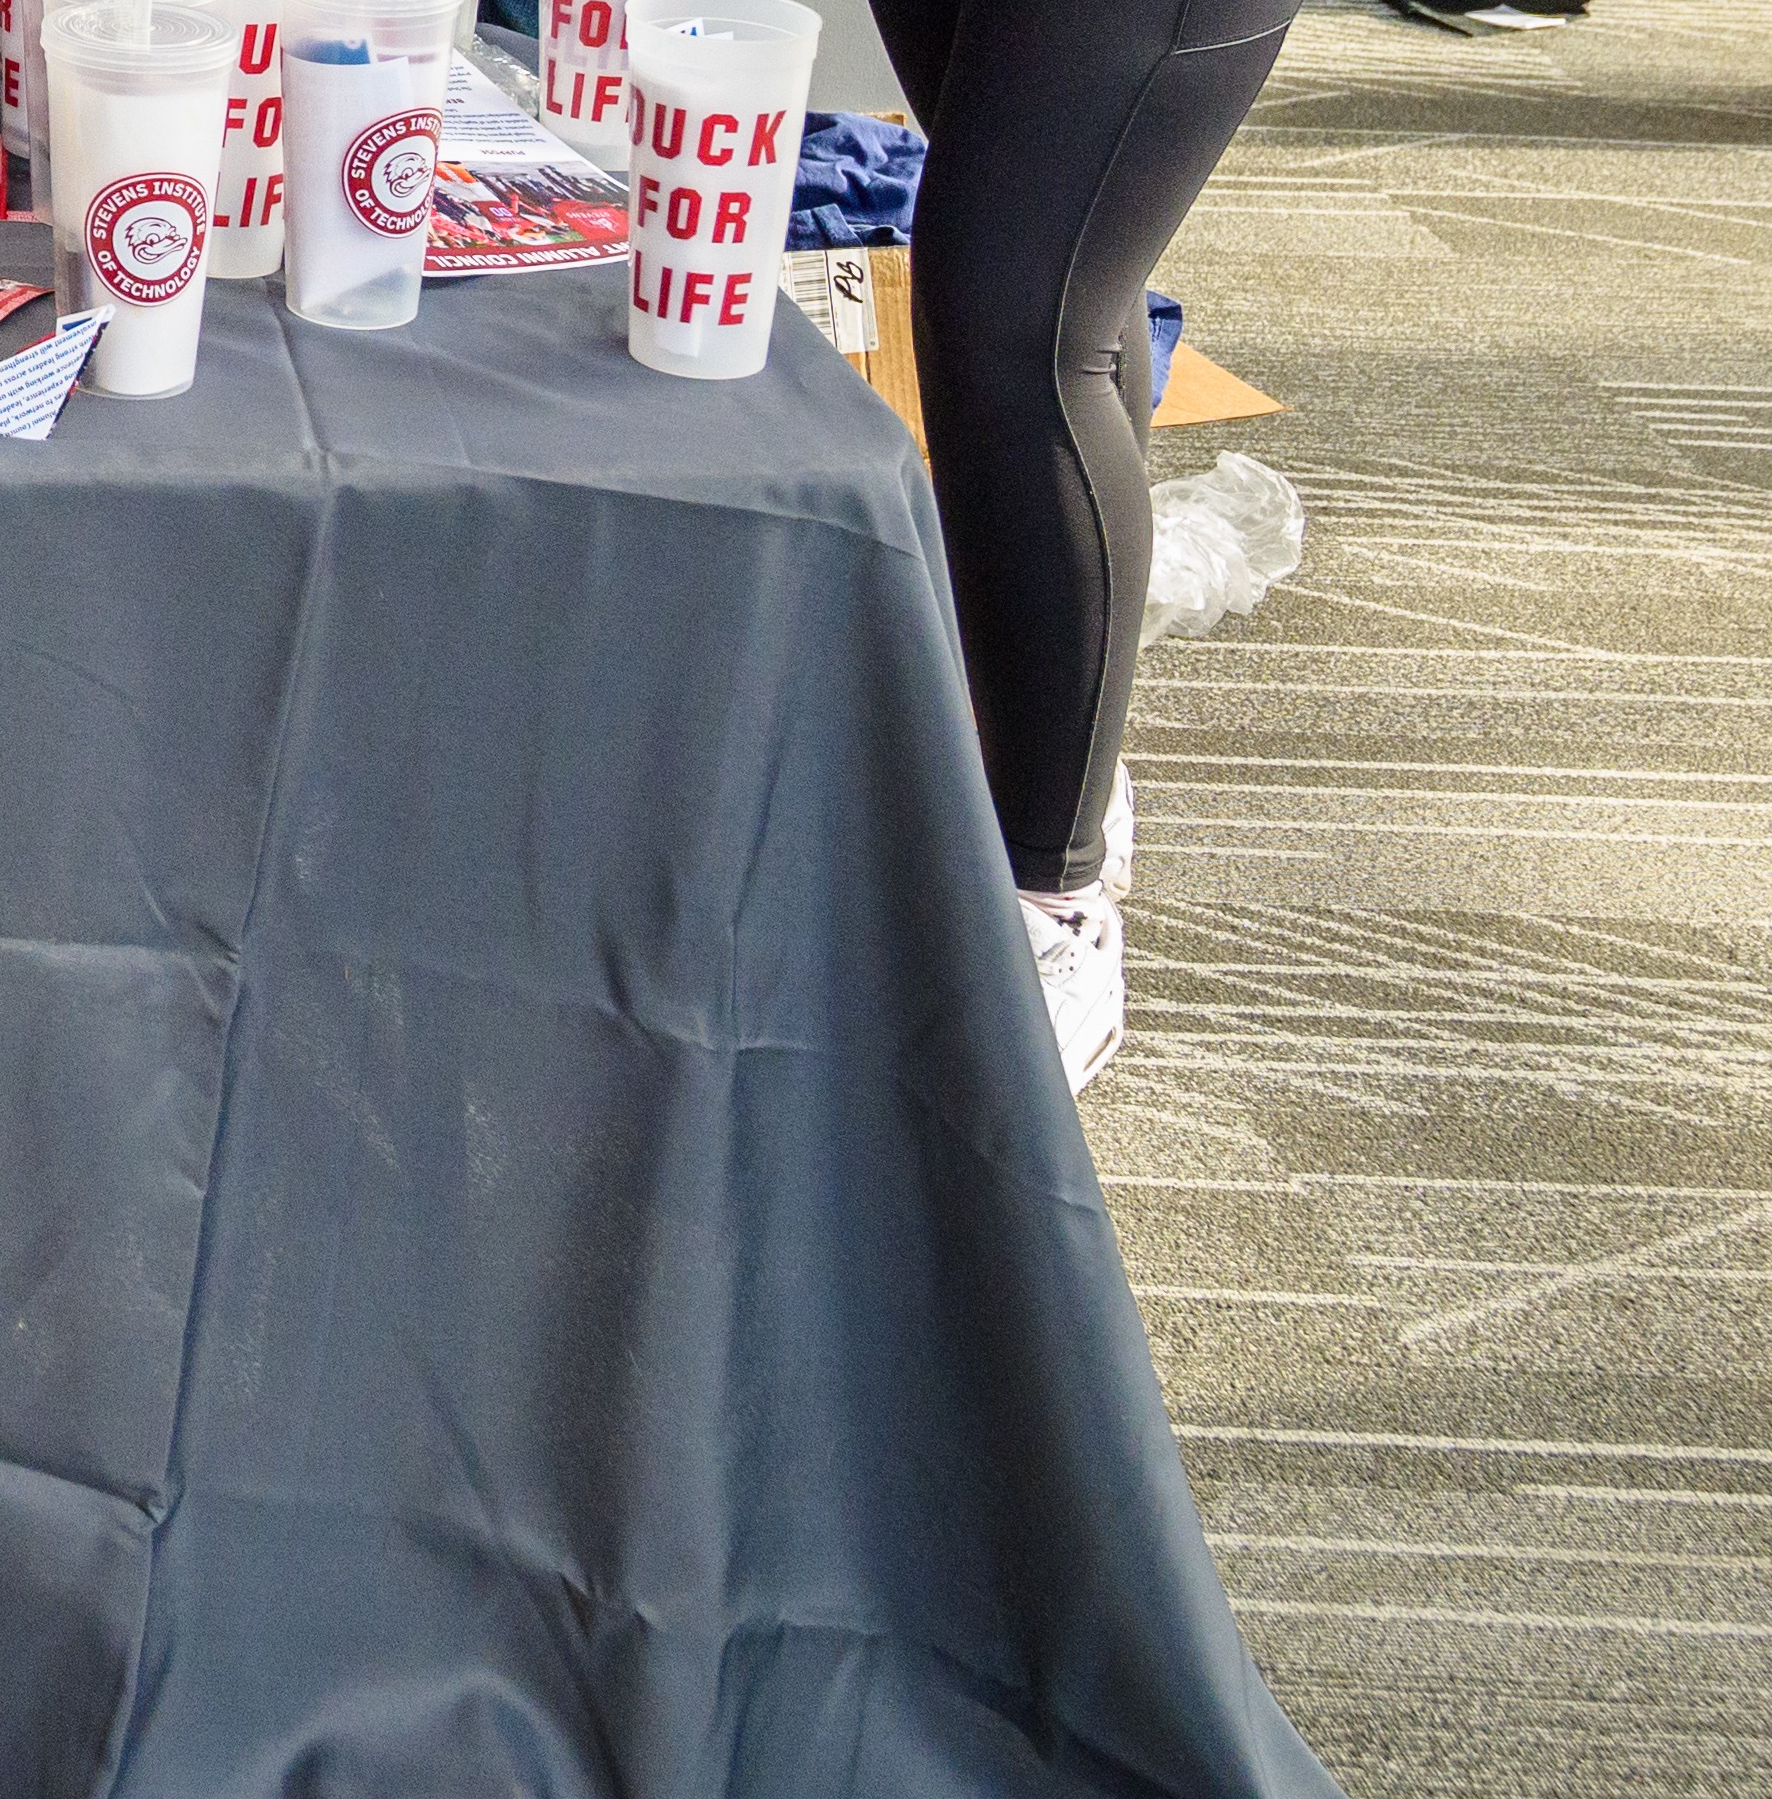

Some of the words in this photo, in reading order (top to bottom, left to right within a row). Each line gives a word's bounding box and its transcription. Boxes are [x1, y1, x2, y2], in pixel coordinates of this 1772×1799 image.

[547, 59, 629, 123] LIF
[351, 121, 406, 180] STEVENS
[629, 83, 787, 167] DUCK
[93, 183, 149, 240] STEVENS
[153, 182, 207, 235] INSTITUTE
[355, 189, 375, 209] OF
[638, 175, 752, 244] FOR
[97, 250, 117, 272] OF
[113, 246, 201, 298] TECHNOLOGY
[427, 254, 520, 268] COUNCIL
[516, 246, 599, 264] ALUMNI
[633, 250, 753, 326] LIFE
[25, 370, 54, 388] working
[28, 357, 55, 374] leaders
